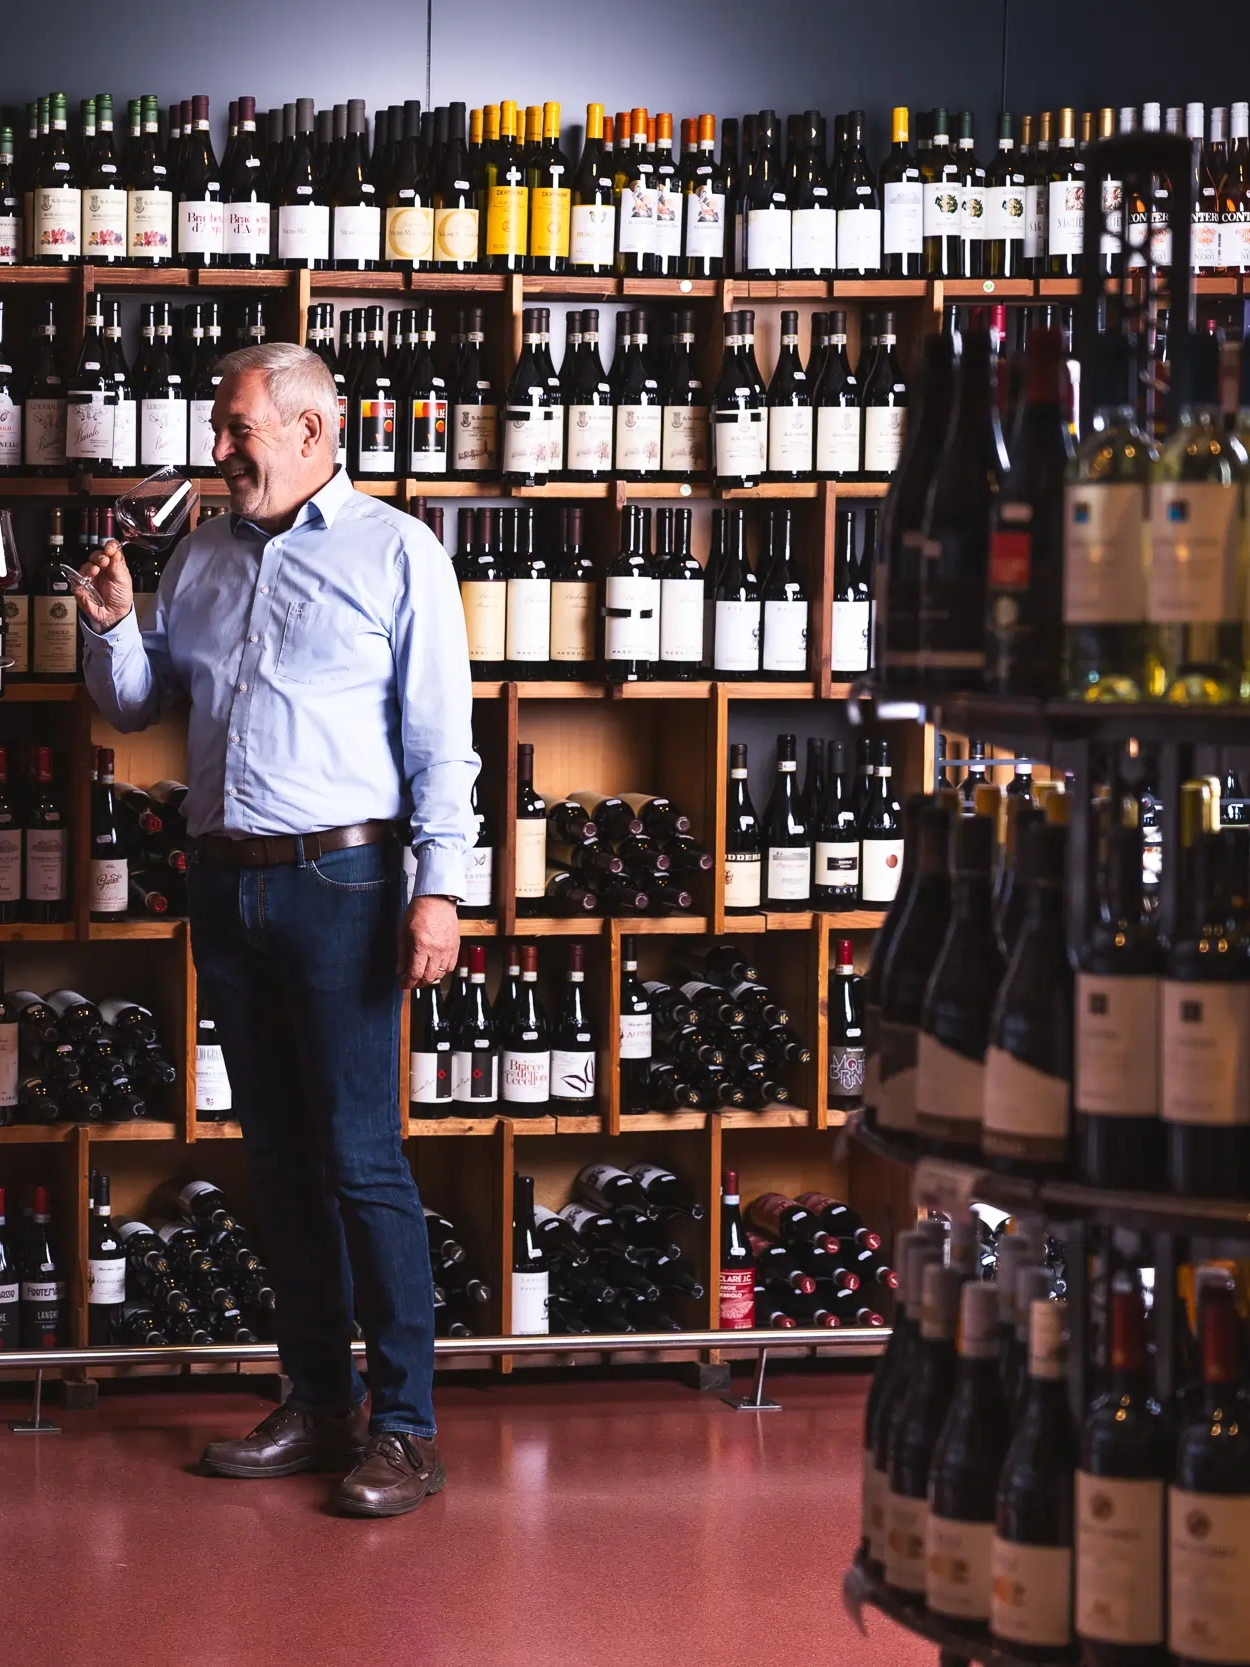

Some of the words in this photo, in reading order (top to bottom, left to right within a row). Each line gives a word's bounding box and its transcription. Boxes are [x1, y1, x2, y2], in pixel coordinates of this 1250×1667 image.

[74, 422, 100, 447] Barolo
[196, 1048, 206, 1061] LIO
[37, 1311, 58, 1320] LANGH
